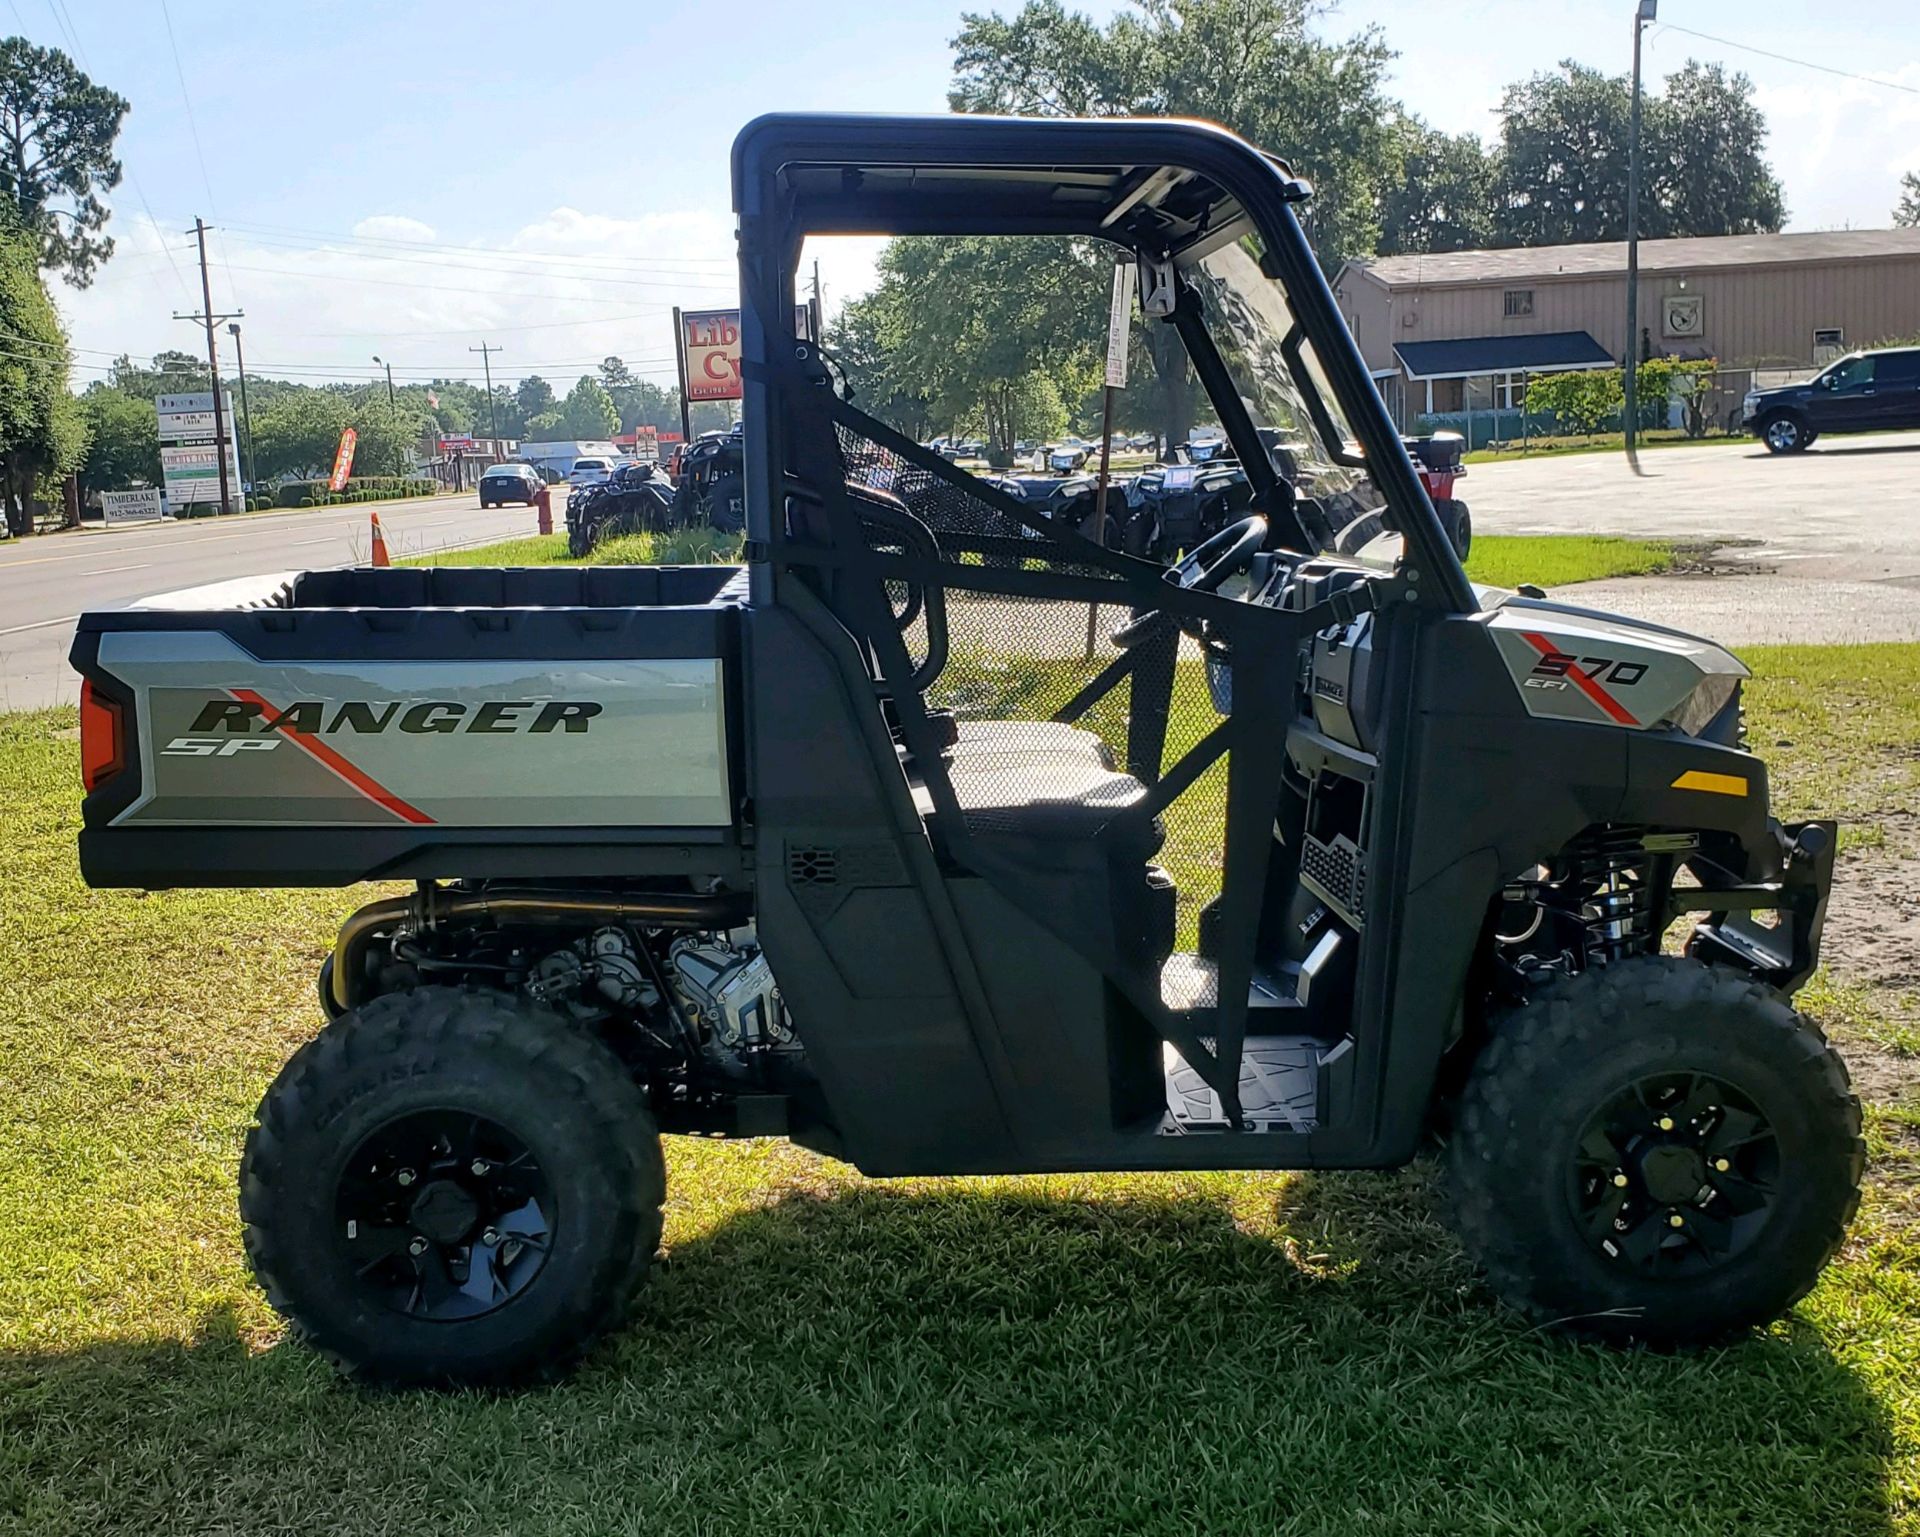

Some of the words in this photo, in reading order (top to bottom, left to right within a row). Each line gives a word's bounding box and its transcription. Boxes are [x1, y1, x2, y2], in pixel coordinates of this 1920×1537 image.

[107, 493, 155, 504] TIMBERLAKE
[1532, 652, 1650, 686] 570
[1523, 678, 1569, 692] EFI
[188, 700, 604, 734] RANGER
[159, 738, 282, 756] SP
